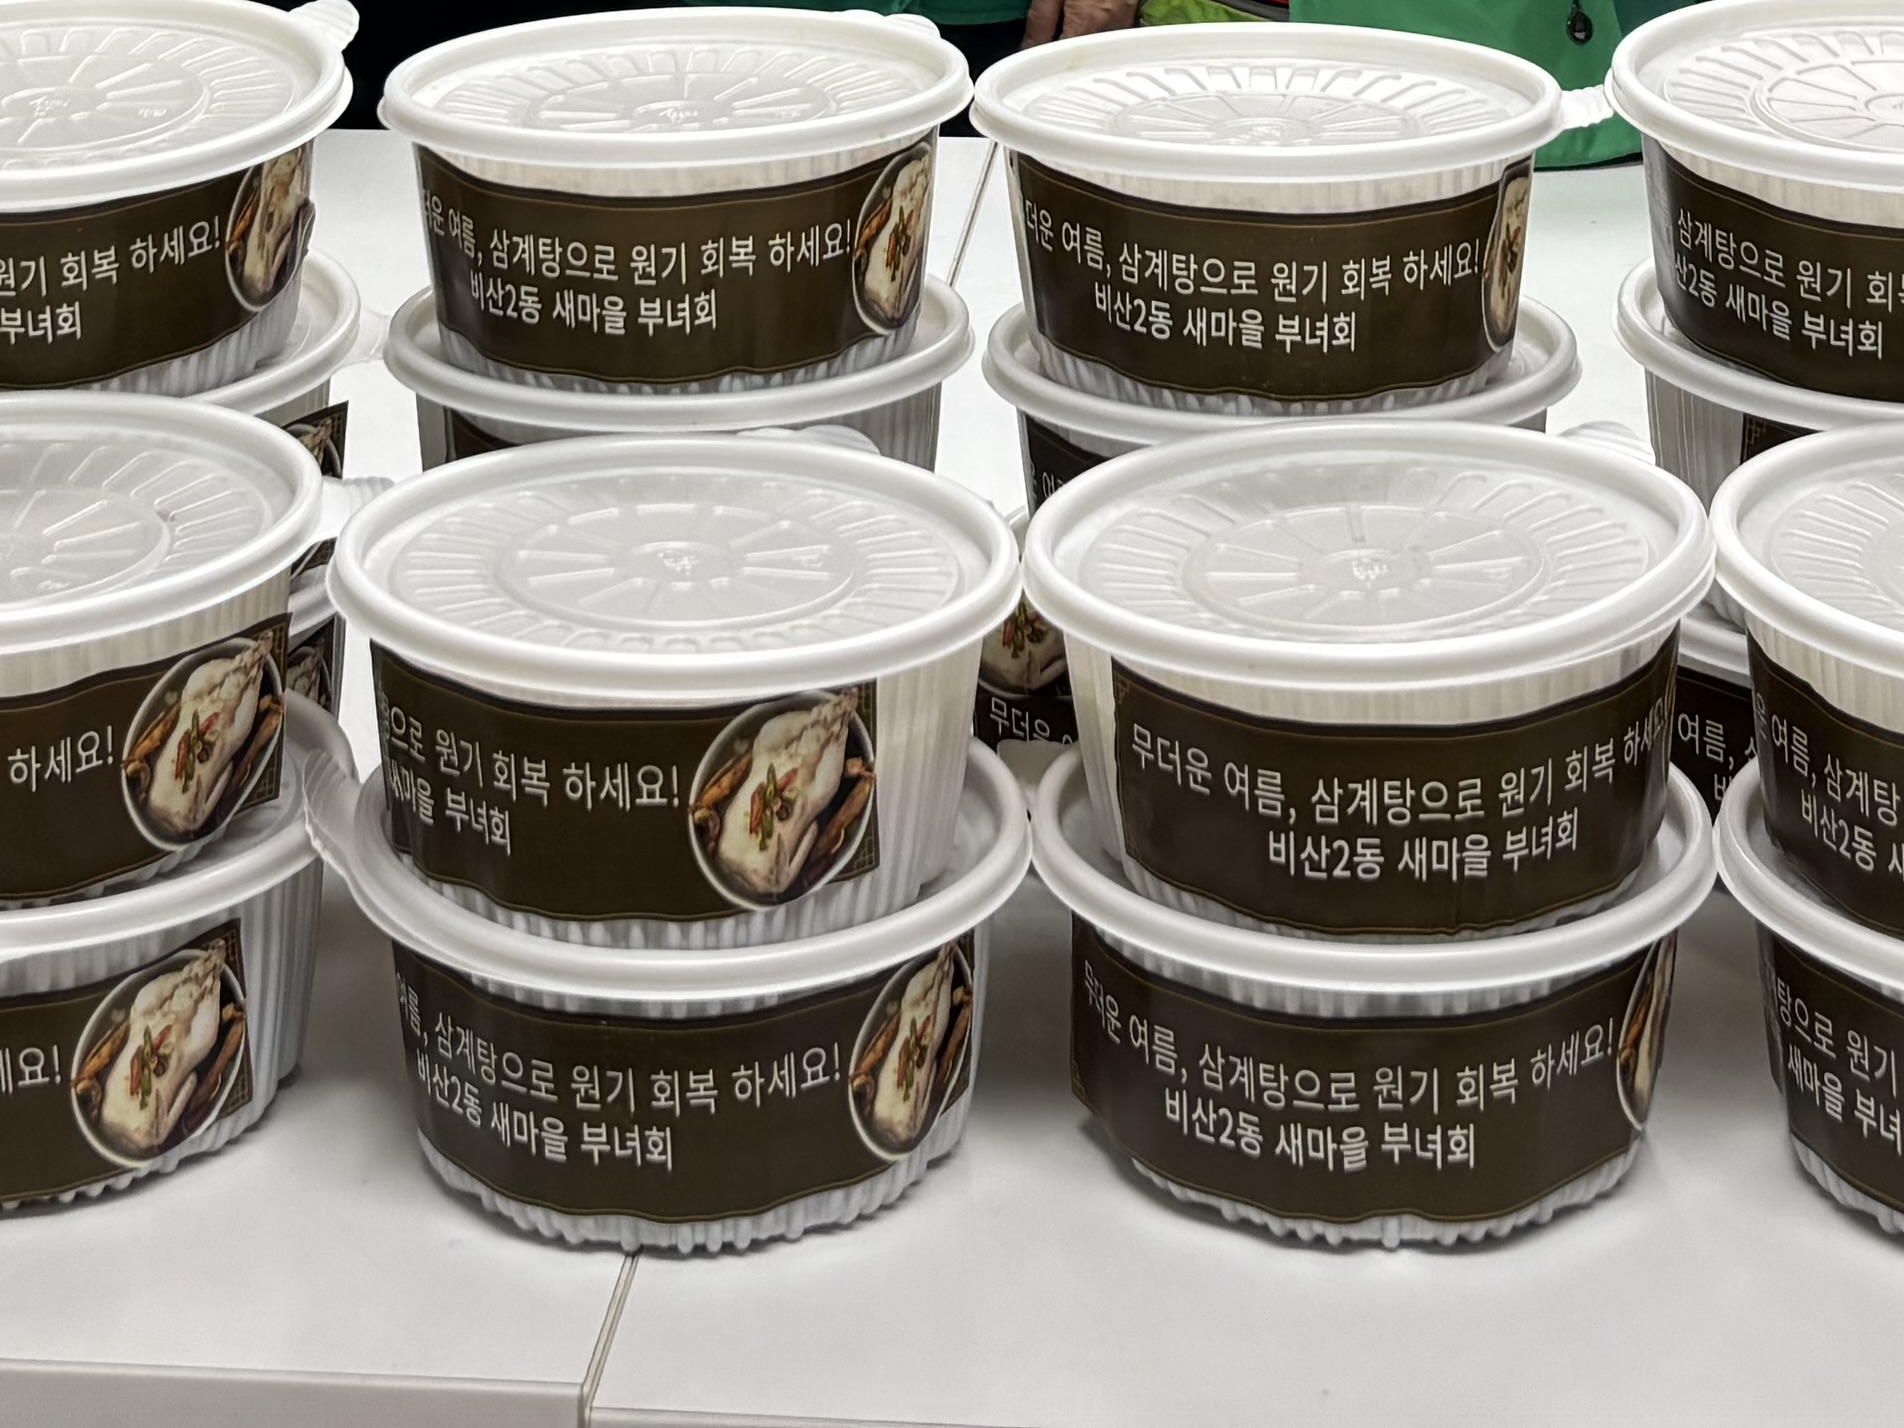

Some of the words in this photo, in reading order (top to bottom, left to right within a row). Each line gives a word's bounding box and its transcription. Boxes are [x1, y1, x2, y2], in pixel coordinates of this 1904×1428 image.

[60, 245, 120, 291] 회복
[130, 215, 221, 273] 하세요!
[448, 207, 483, 266] 여름,
[489, 228, 619, 281] 삼계탕으로
[630, 243, 687, 285] 원기
[700, 235, 756, 277] 회복
[768, 219, 851, 272] 하세요!
[1061, 222, 1111, 278] 여름,
[1118, 243, 1259, 295] 삼계탕으로
[1270, 260, 1328, 304] 원기
[1341, 254, 1393, 300] 회복
[1402, 238, 1480, 290] 하세요!
[1677, 208, 1787, 289] 삼계탕으로
[1796, 260, 1852, 309] 원기
[470, 269, 542, 323] 비산2동
[552, 289, 627, 335] 새마을
[637, 289, 717, 337] 부녀회
[1094, 282, 1174, 340] 비산2동
[1183, 307, 1265, 349] 새마을
[1274, 311, 1356, 354] 부녀회
[1725, 283, 1792, 341] 새마을
[1801, 310, 1884, 359] 부녀회
[7, 725, 114, 793] 하세요!
[436, 728, 483, 788] 원기
[493, 750, 550, 807] 회복
[563, 761, 679, 813] 하세요!
[1131, 722, 1213, 797] 무더운
[1224, 762, 1296, 825] 여름,
[1311, 775, 1485, 827] 삼계탕으로
[1498, 758, 1555, 820] 원기
[1564, 738, 1616, 793] 회복
[1676, 711, 1734, 773] 여름,
[1771, 714, 1817, 788] 여름,
[446, 787, 511, 857] 부녀회
[1267, 829, 1385, 880] 비산2동
[1397, 832, 1492, 883] 새마을
[1502, 808, 1579, 872] 부녀회
[1800, 787, 1877, 874] 비산2동
[435, 1012, 558, 1103] 삼계탕으로
[571, 1065, 635, 1114] 원기
[650, 1069, 719, 1117] 회복
[732, 1042, 840, 1108] 하세요!
[1083, 959, 1122, 1044] 무더운
[1129, 1014, 1188, 1083] 여름,
[1198, 1044, 1361, 1112] 삼계탕으로
[1372, 1066, 1439, 1114] 원기
[1456, 1057, 1519, 1112] 회복
[1530, 1018, 1613, 1090] 하세요!
[1846, 1029, 1897, 1099] 원기
[417, 1051, 482, 1129] 비산2동
[491, 1100, 568, 1163] 새마을
[580, 1122, 672, 1172] 부녀회
[1788, 1043, 1845, 1123] 새마을
[1165, 1087, 1263, 1158] 비산2동
[1275, 1122, 1369, 1171] 새마을
[1380, 1121, 1475, 1169] 부녀회
